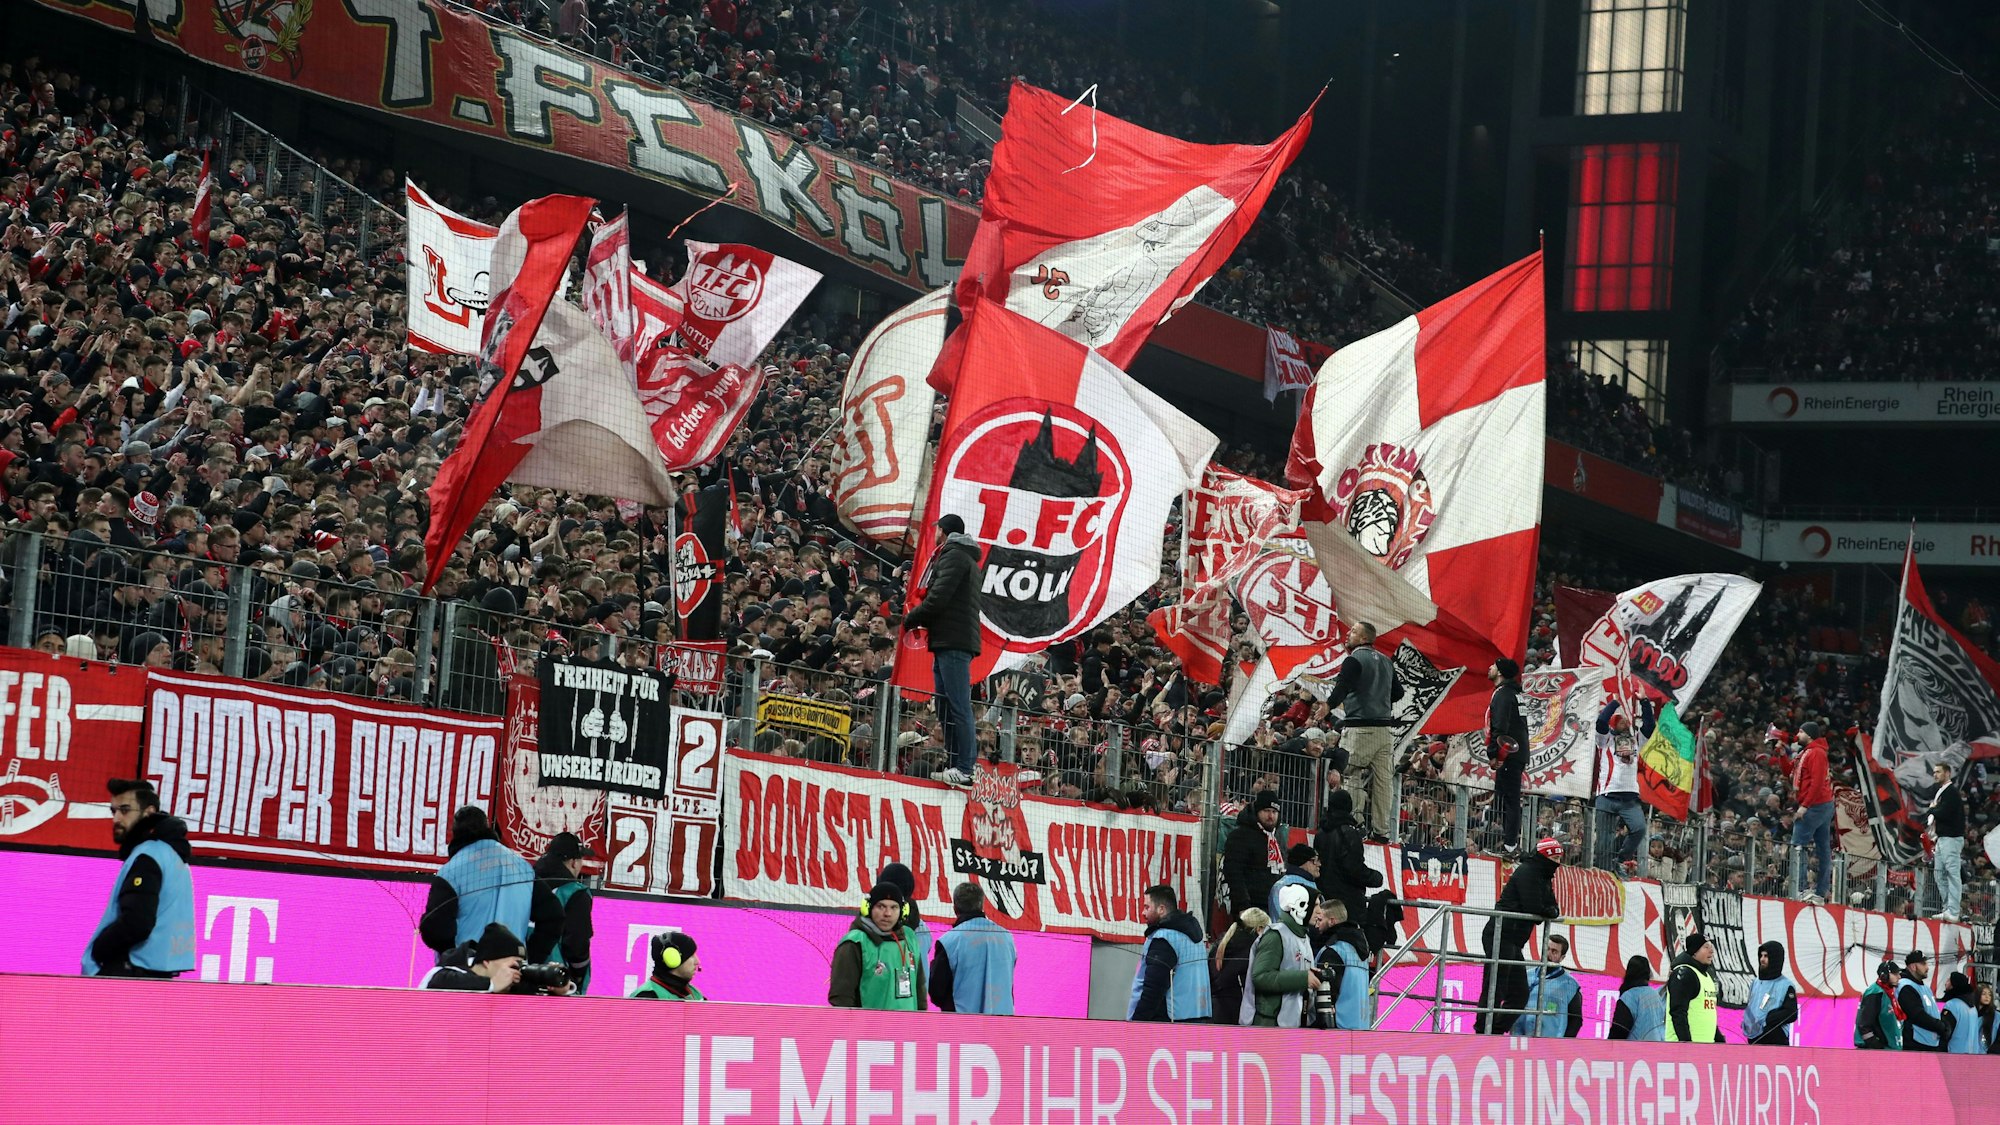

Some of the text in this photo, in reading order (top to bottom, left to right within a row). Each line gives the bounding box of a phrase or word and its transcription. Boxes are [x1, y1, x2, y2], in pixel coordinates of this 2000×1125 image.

[698, 267, 750, 299] 1.FC
[1803, 396, 1900, 412] RheinEnergie
[1944, 387, 1994, 401] Rhein
[666, 397, 711, 451] bleiben
[978, 487, 1106, 549] 1.FC
[1837, 536, 1935, 553] RheinEnegie
[981, 559, 1075, 602] KÖLN
[552, 662, 660, 701] FREIHEIT FÜR
[147, 687, 497, 858] SEMPER FIDELIS
[540, 752, 662, 790] UNSERE BRÜDER
[679, 719, 718, 789] 2
[630, 794, 701, 815] REVOLTE
[735, 769, 1194, 925] DOMSTADT SYNDIKAT
[955, 847, 992, 873] SEIT
[779, 1036, 1001, 1125] MEHR
[1023, 1044, 1127, 1125] IHR
[1147, 1048, 1274, 1125] SEID
[1299, 1051, 1461, 1125] DESTO
[1472, 1036, 1700, 1125] GÜNSTIGER
[1707, 1062, 1821, 1125] WIRD'S
